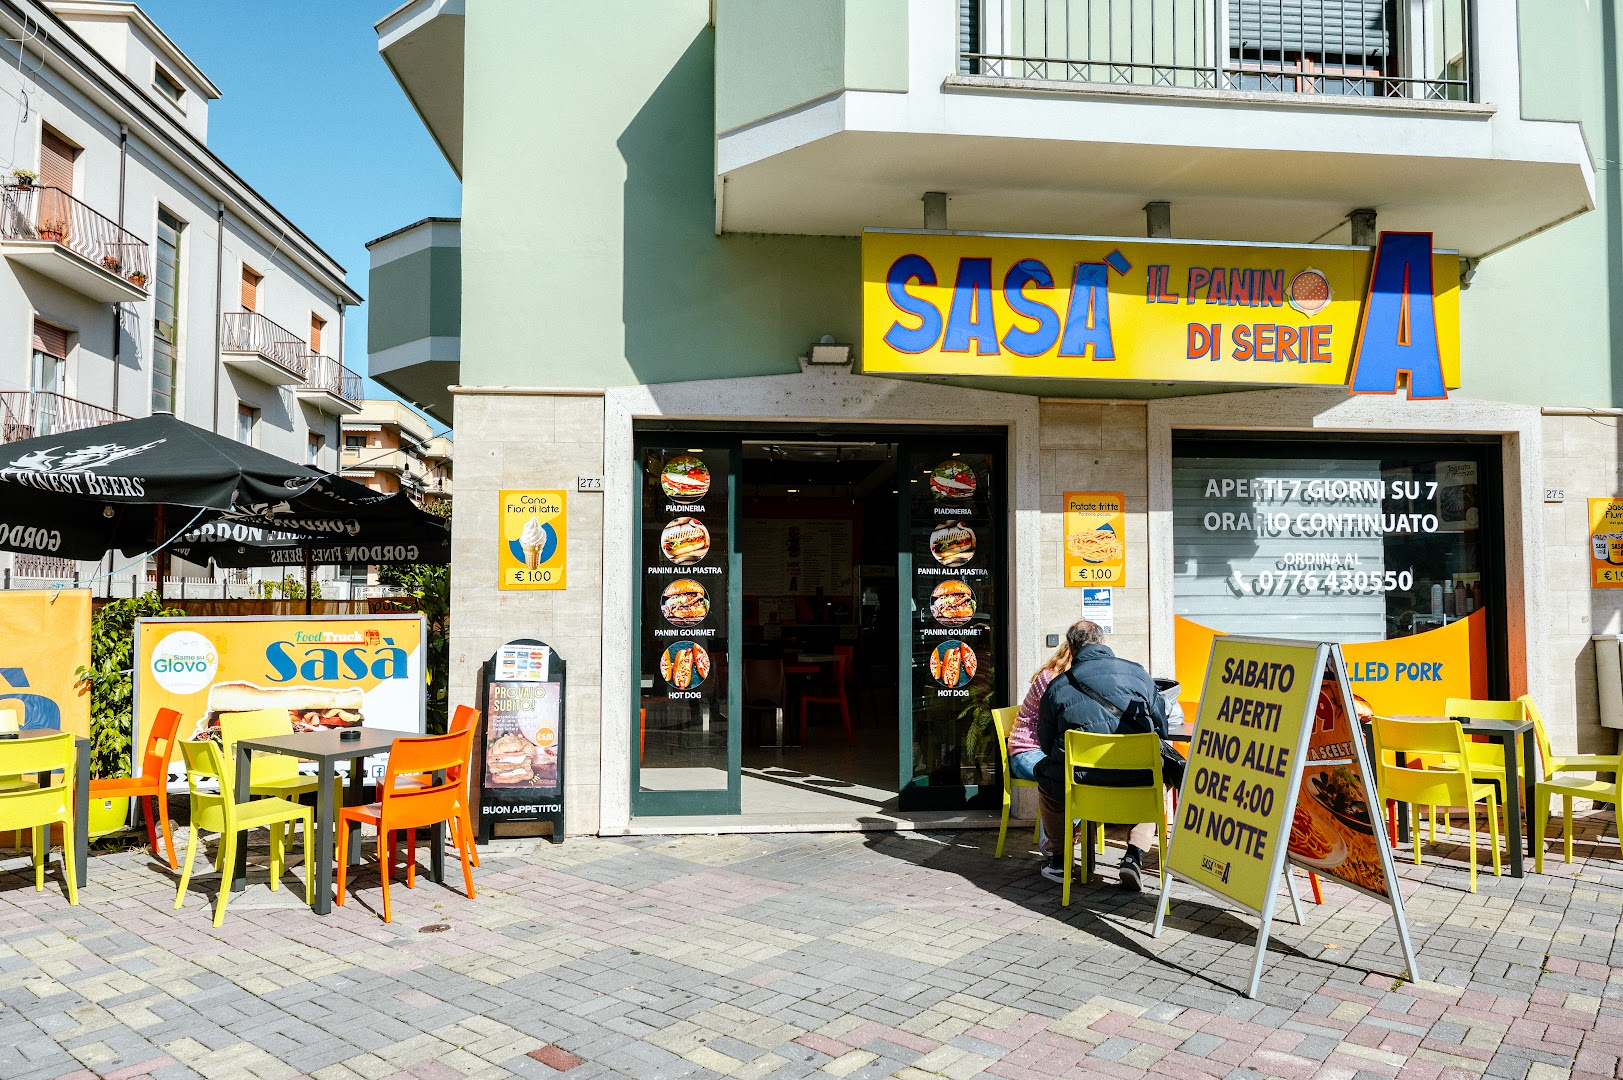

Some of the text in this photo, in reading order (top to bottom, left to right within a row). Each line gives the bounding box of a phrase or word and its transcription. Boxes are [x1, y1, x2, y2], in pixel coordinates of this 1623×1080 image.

[1147, 265, 1178, 304] IL
[1187, 231, 1448, 400] DI SERIE A
[580, 478, 601, 488] 273
[1205, 478, 1438, 500] APERTI 7 GIORNI SU 7
[520, 495, 547, 505] Cono
[1546, 489, 1565, 499] 275
[507, 504, 560, 513] Fior di latte
[665, 504, 705, 513] PIADINERIA
[934, 507, 972, 516] PIADINERIA
[1070, 501, 1119, 511] Patate fritte
[1204, 512, 1439, 533] ORARIO CONTINUATO
[1284, 553, 1362, 565] ORDINA AL
[515, 570, 551, 582] € 1,00
[648, 566, 722, 575] PANINI ALLA PIASTRA
[917, 567, 988, 576] PANINI ALLA PIASTRA
[1079, 568, 1112, 580] € 1,00
[1604, 570, 1612, 580] €
[1259, 570, 1412, 591] 0776 430550
[295, 630, 362, 643] Food Truck
[654, 628, 715, 637] PANINI GOURMET
[924, 628, 982, 637] PANINI GOURMET
[154, 658, 207, 673] Glovo
[265, 637, 409, 683] Sasà
[1221, 657, 1295, 693] SABATO
[1396, 662, 1443, 682] PORK
[494, 686, 546, 699] PROVALO
[668, 691, 702, 700] HOT DOG
[937, 689, 969, 698] HOT DOG
[494, 699, 536, 712] SUBITO!
[1216, 695, 1283, 733] APERTI
[1197, 729, 1290, 778] FINO ALLE
[1194, 767, 1274, 818] ORE 4:00
[483, 804, 561, 815] BUON APPETITO!
[1184, 803, 1268, 861] DI NOTTE
